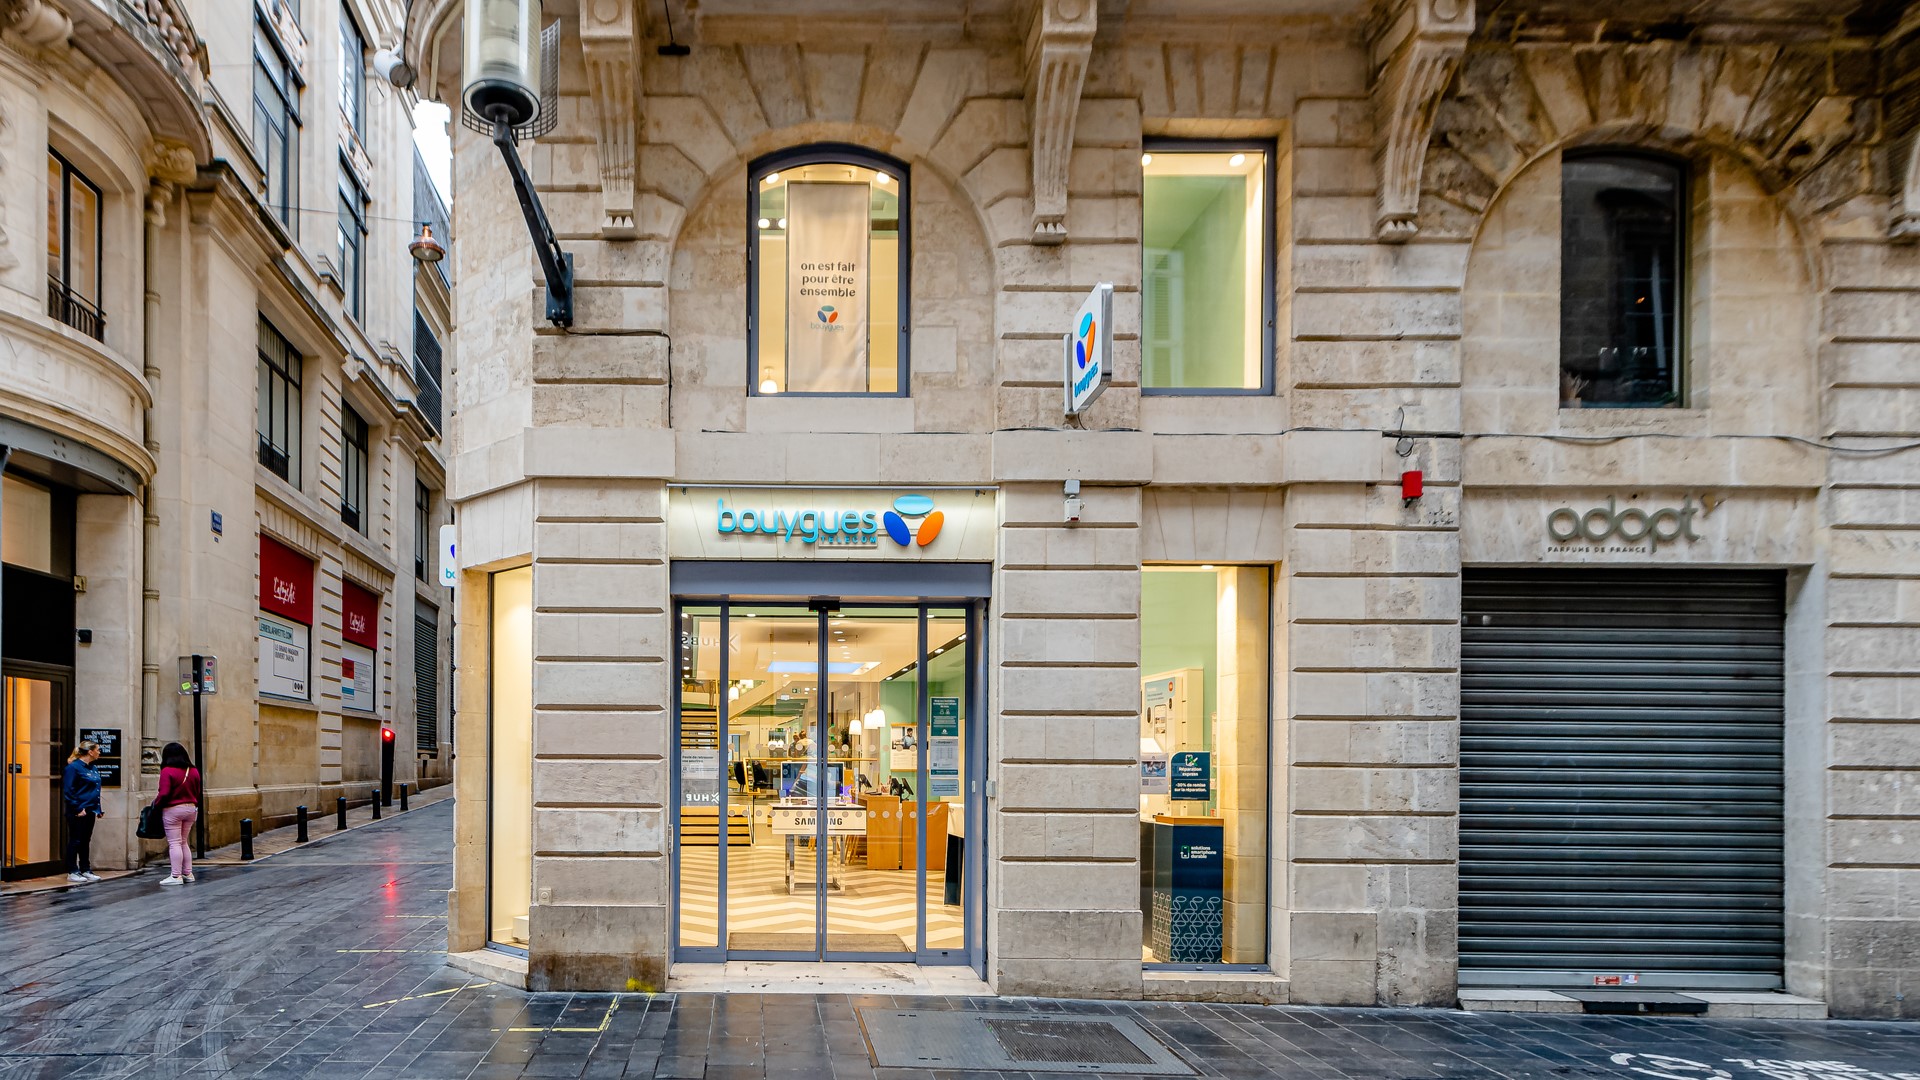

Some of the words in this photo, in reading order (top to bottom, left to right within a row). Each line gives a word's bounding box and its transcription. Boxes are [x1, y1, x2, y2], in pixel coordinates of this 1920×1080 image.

[800, 262, 815, 271] on
[817, 262, 835, 271] est
[837, 261, 856, 272] fait
[802, 275, 830, 286] pour
[831, 273, 855, 285] être
[799, 287, 856, 297] ensemble
[1074, 361, 1099, 398] bouygues
[718, 498, 878, 543] bouygues
[821, 535, 877, 544] TELECOM
[794, 817, 843, 826] SAMNG
